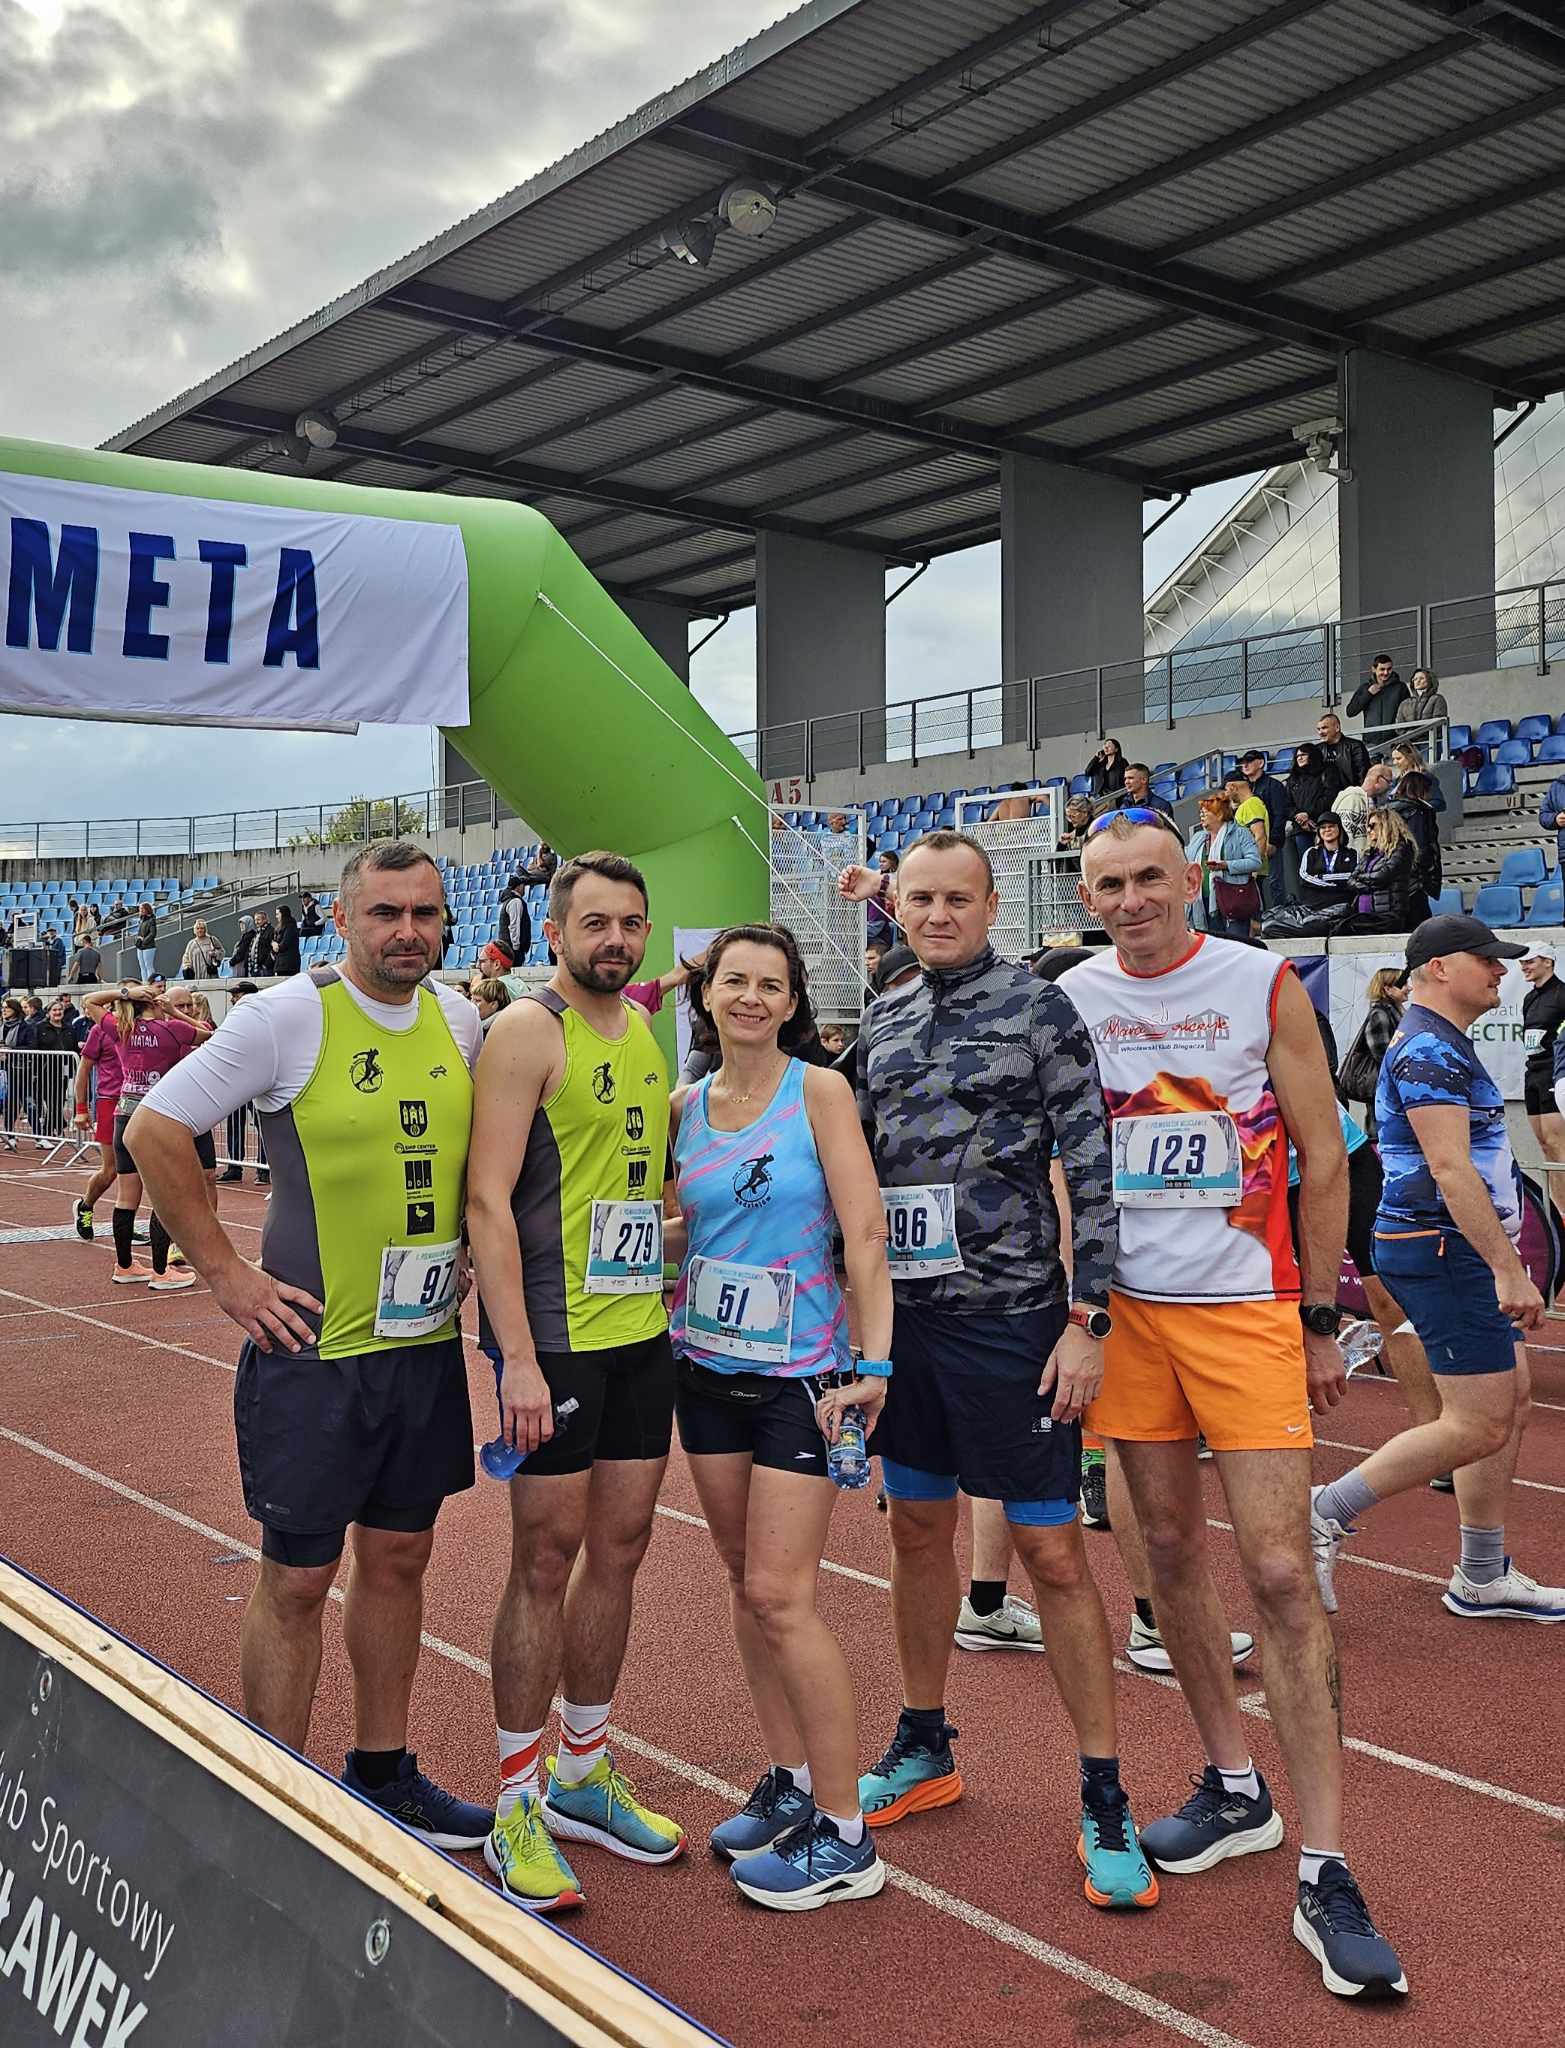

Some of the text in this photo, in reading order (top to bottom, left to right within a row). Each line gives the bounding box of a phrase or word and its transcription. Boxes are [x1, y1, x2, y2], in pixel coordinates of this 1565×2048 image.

[6, 517, 321, 670] META
[771, 779, 801, 804] A5
[1147, 1133, 1207, 1175] 123
[613, 1222, 654, 1263] 279
[419, 1258, 456, 1305] 97
[716, 1282, 750, 1326] 51
[31, 1796, 175, 1981] Sportowy
